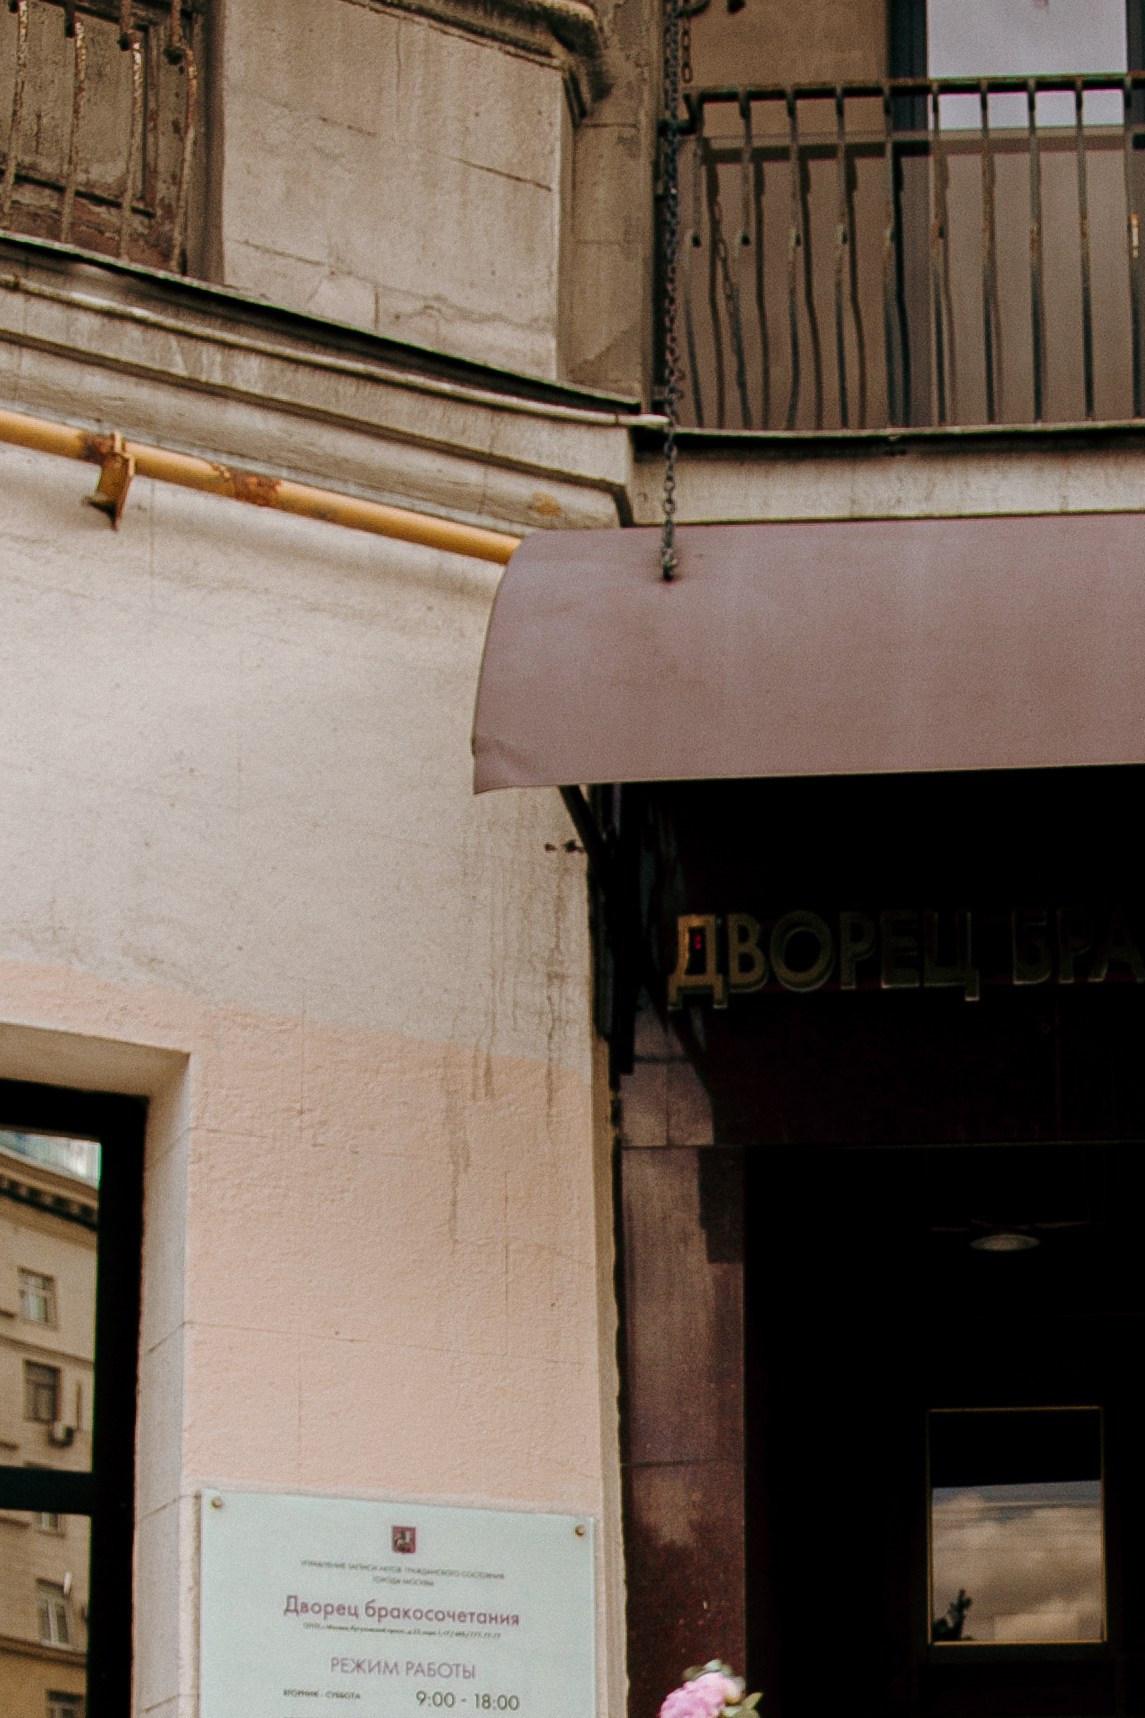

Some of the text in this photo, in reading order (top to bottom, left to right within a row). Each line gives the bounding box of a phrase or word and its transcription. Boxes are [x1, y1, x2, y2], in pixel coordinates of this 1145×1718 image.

[667, 910, 980, 1010] ДВОРЕЦ
[283, 1594, 520, 1626] Дворец бракосочетания
[330, 1656, 476, 1680] РЕЖИМ РАБОТЫ
[416, 1690, 456, 1708] 9:00
[474, 1693, 520, 1711] 18:00
